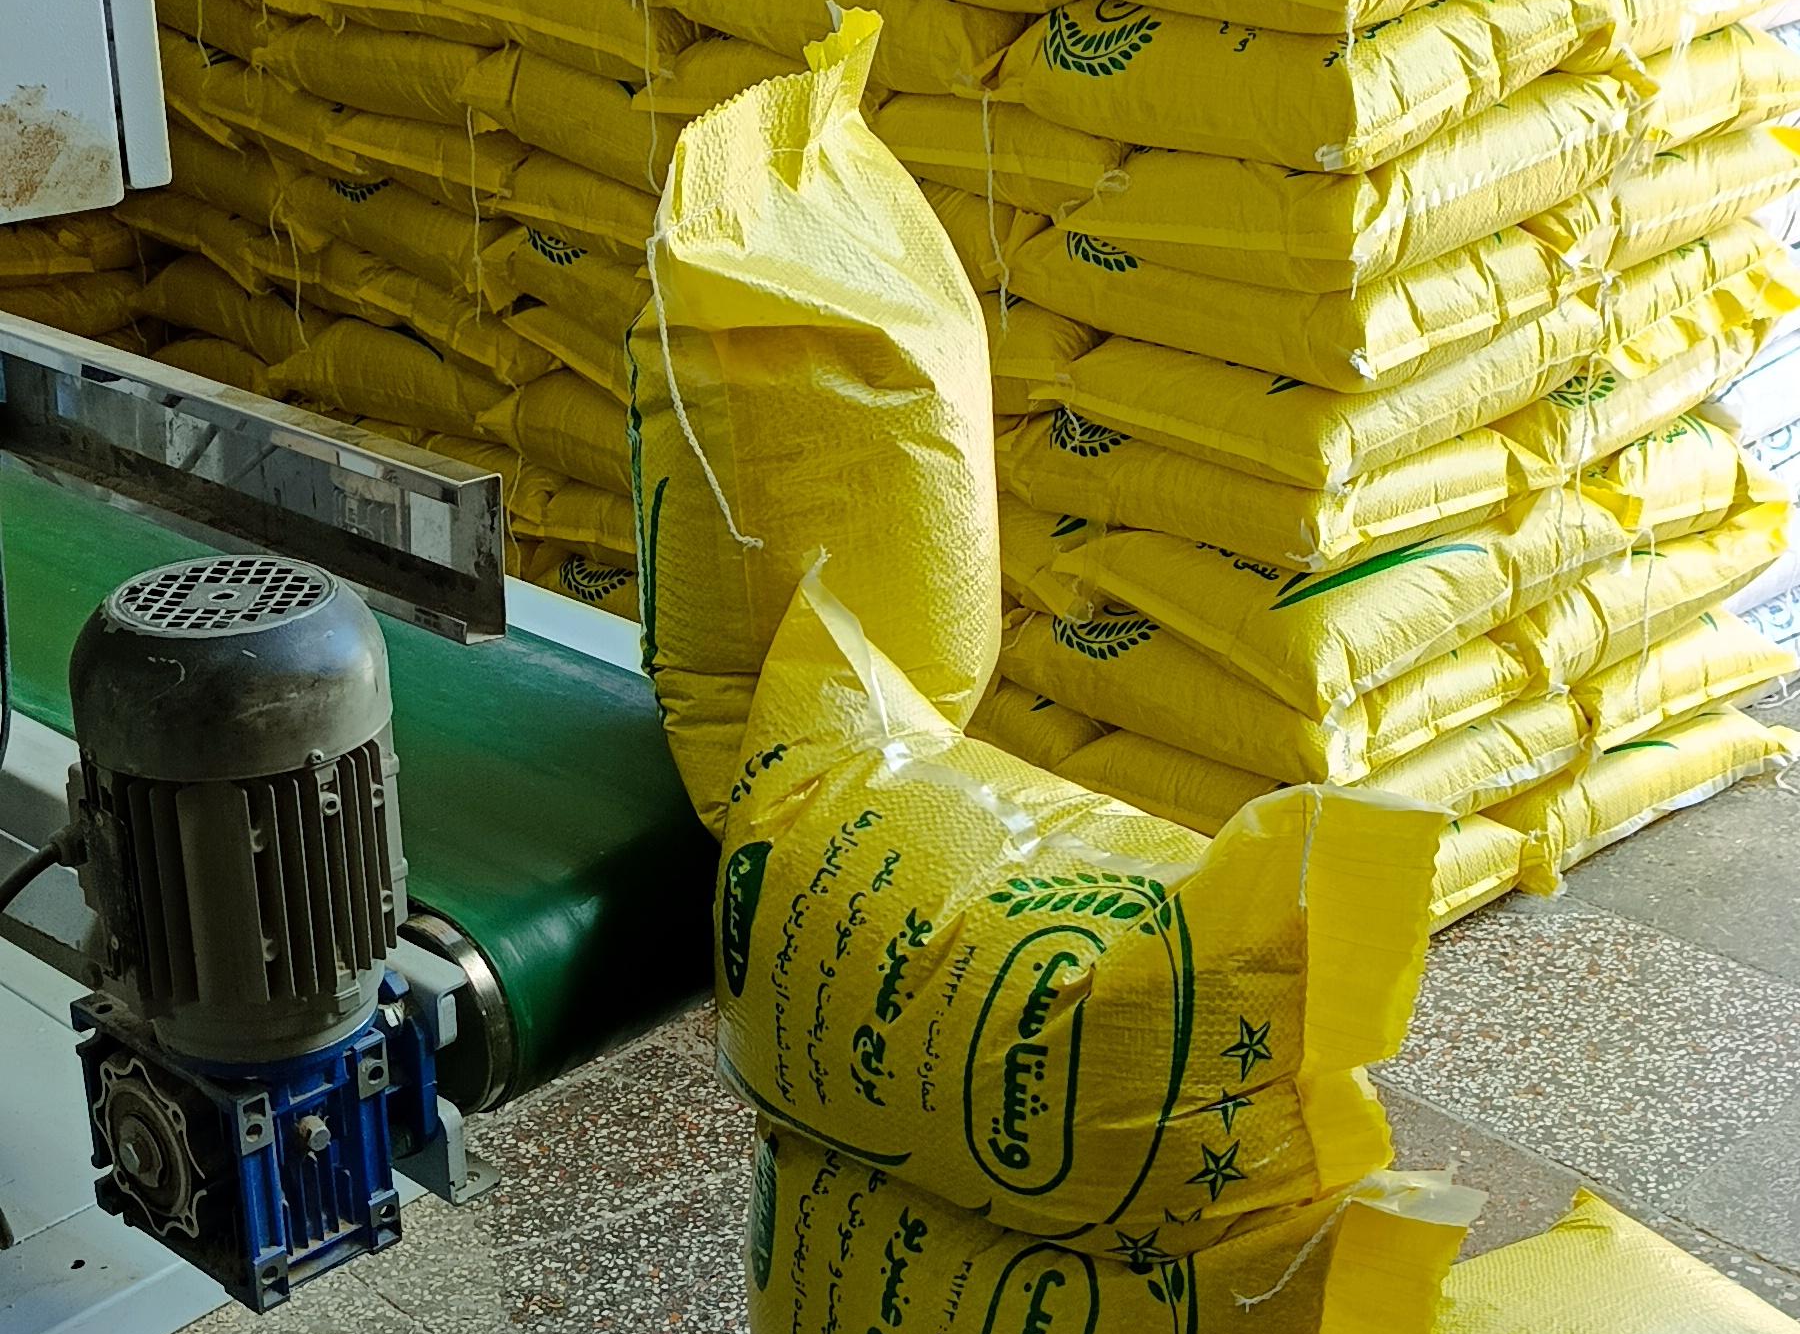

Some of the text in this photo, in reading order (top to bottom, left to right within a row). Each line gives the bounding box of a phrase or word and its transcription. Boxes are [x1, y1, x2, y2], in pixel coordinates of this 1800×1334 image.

[1233, 558, 1280, 581] طعمی
[775, 893, 812, 977] بهترین
[769, 972, 791, 999] از
[806, 848, 901, 1106] خوش پخت و خوش طعم
[773, 1003, 791, 1051] شده
[774, 1053, 797, 1108] تولید
[849, 1024, 894, 1107] برنج
[917, 1062, 937, 1113] شماره
[985, 951, 1079, 1170] ویشتاسب
[793, 1195, 814, 1273] بهترین
[828, 1261, 842, 1278] و
[837, 1193, 864, 1261] خوش
[790, 1271, 806, 1298] از
